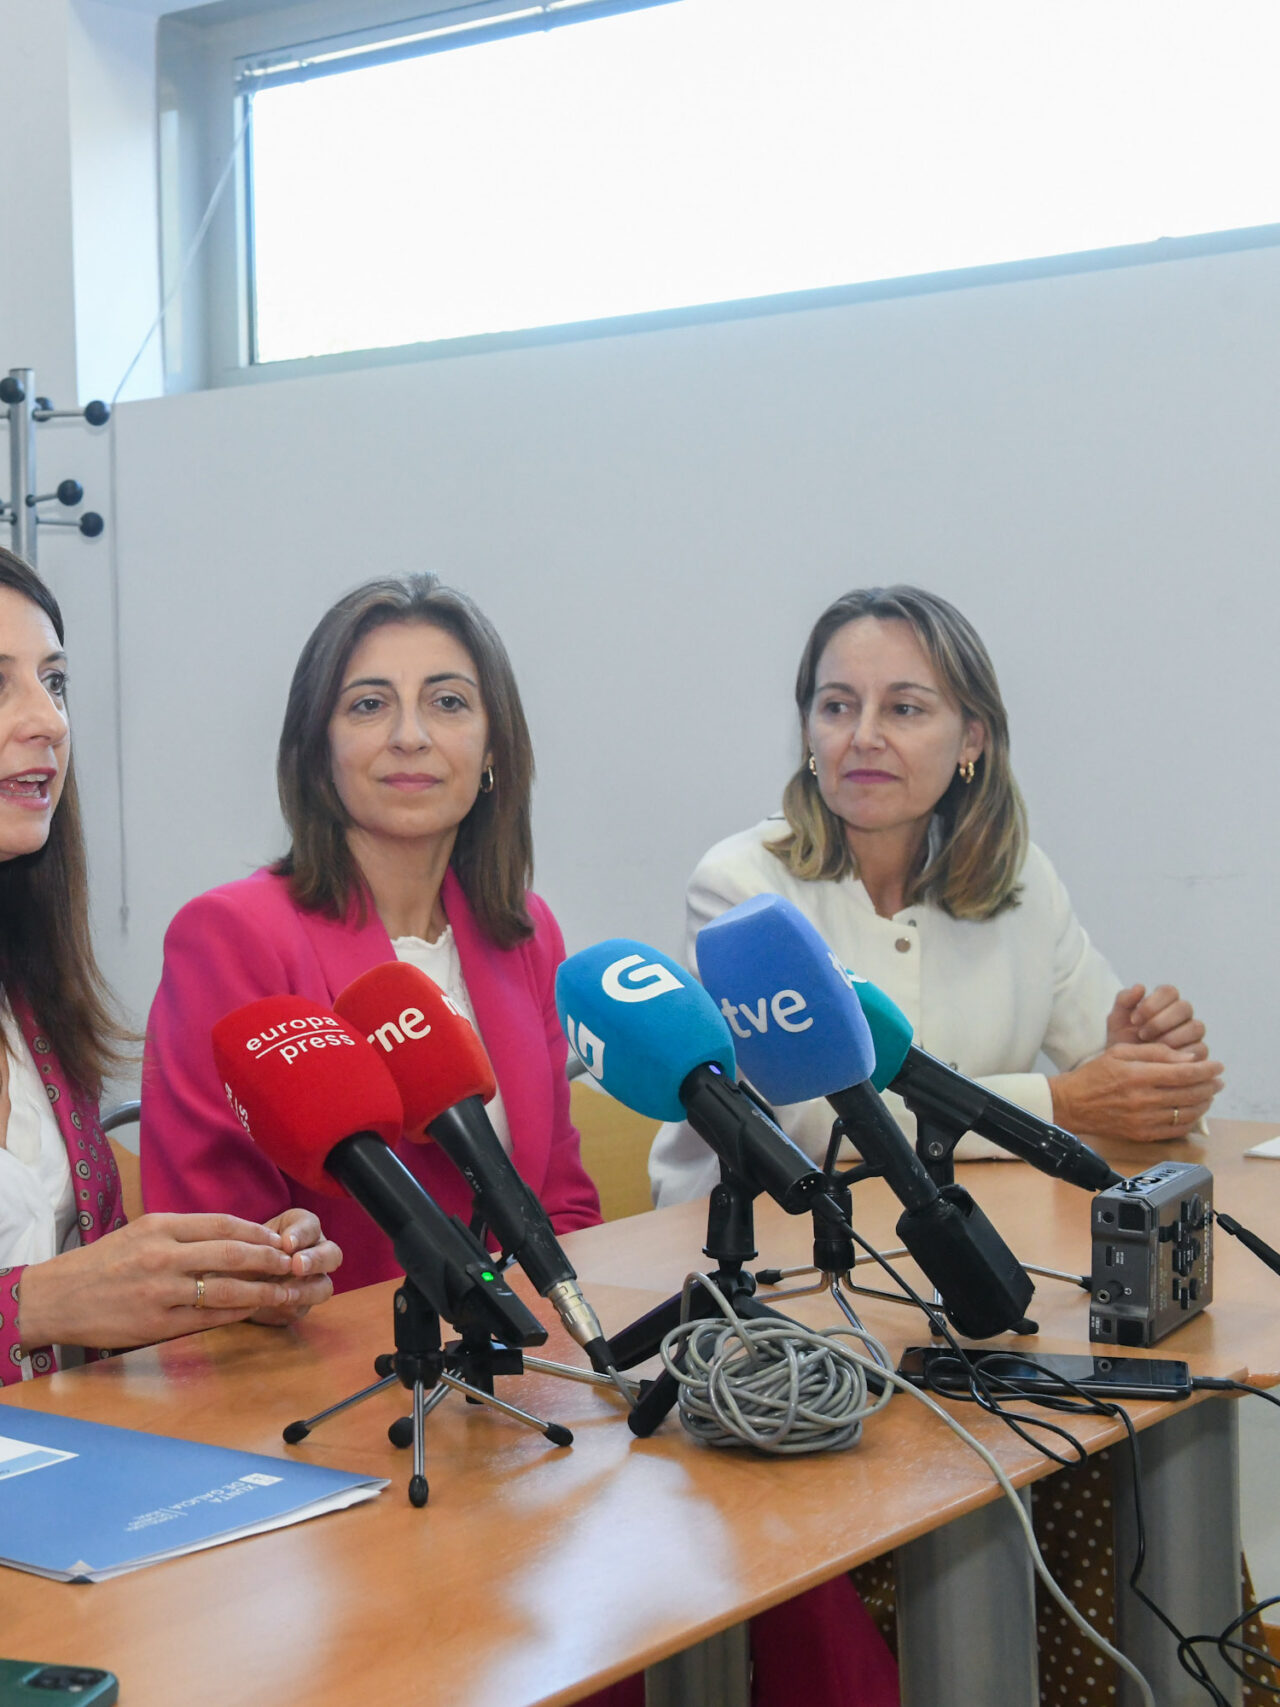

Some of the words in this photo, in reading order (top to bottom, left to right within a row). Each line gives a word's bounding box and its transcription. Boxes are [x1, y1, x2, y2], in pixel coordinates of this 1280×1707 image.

[721, 989, 814, 1038] tve
[245, 1014, 339, 1051] europa
[279, 1031, 356, 1065] press
